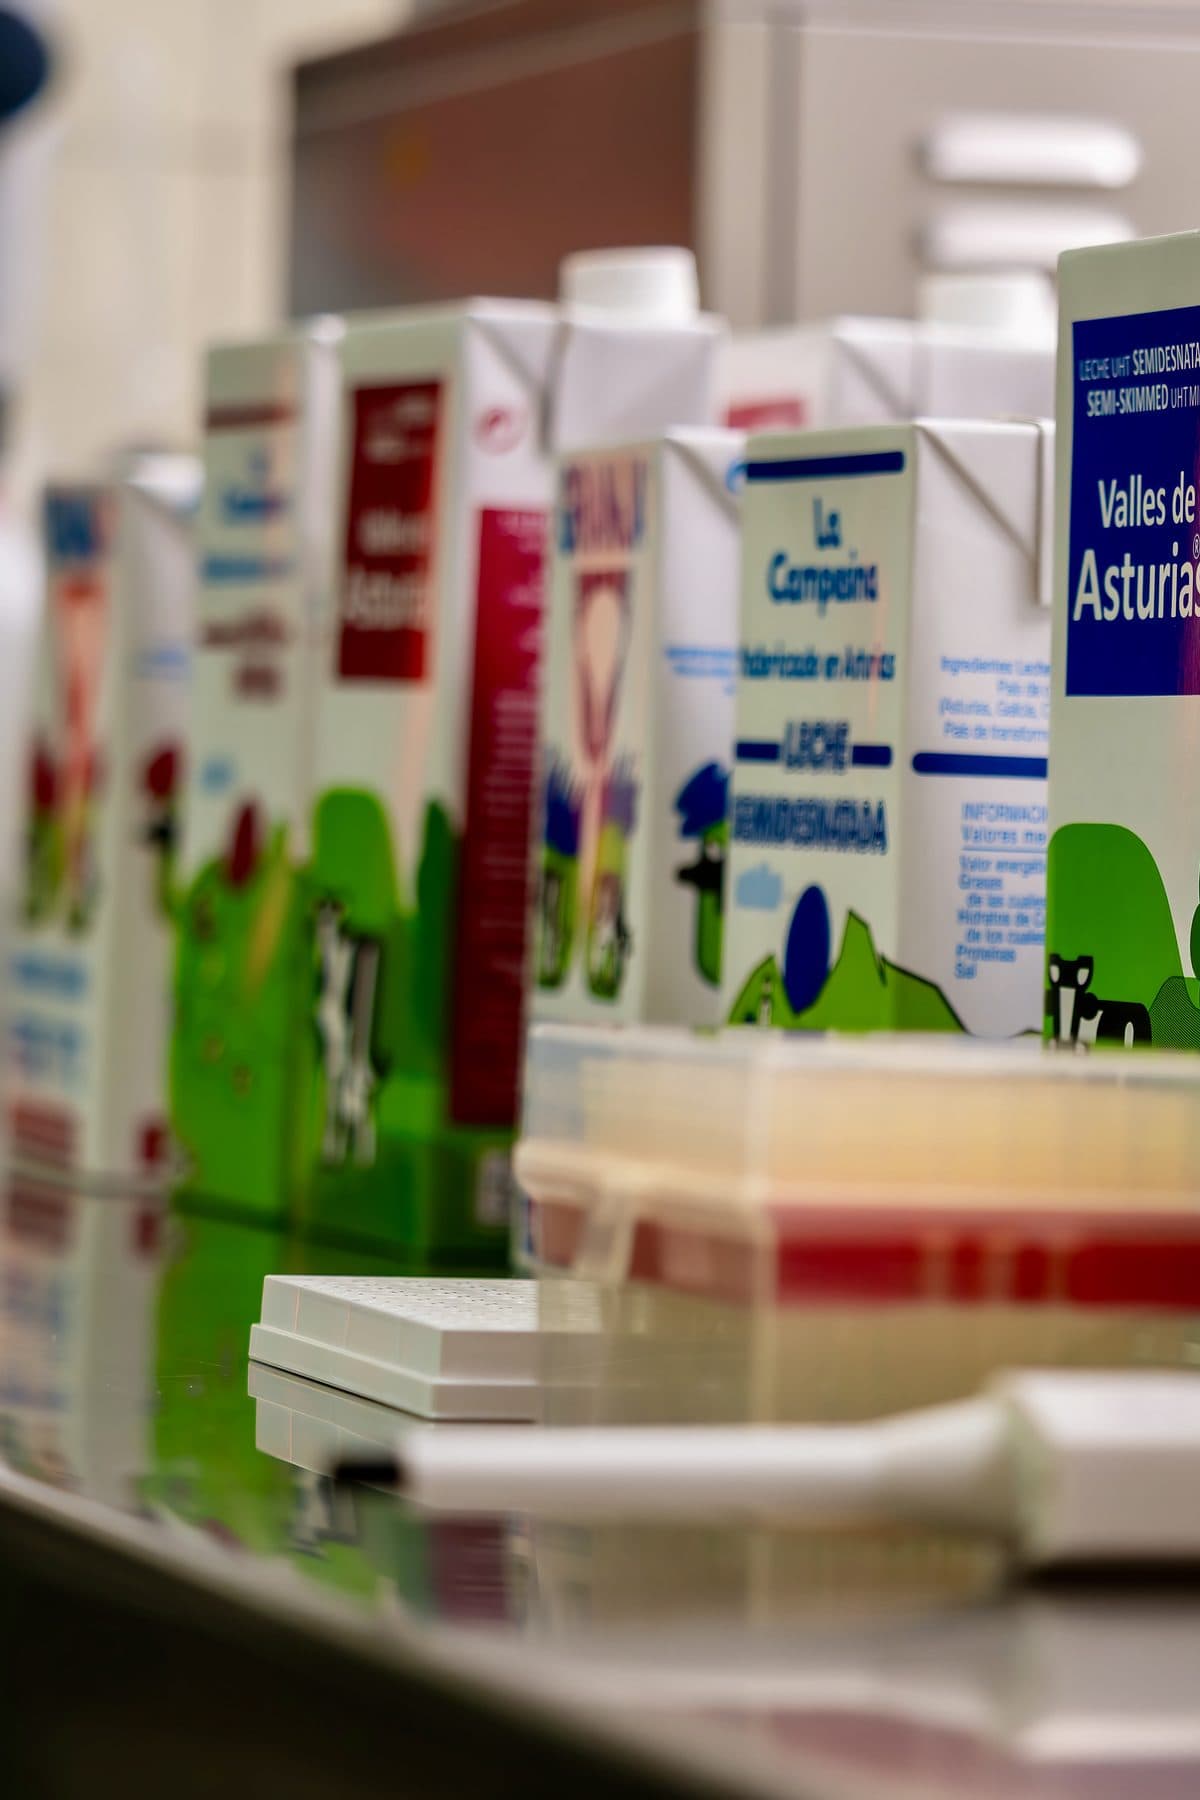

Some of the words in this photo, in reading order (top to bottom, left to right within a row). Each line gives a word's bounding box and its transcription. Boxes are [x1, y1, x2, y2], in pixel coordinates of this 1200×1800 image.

[1079, 357, 1110, 381] LECHE
[1111, 355, 1130, 378] UHT
[1086, 383, 1169, 417] SEMI-SKIMMED
[1170, 387, 1188, 408] UHT
[1098, 474, 1166, 528] Valles
[1172, 471, 1196, 524] de
[813, 497, 842, 550] La
